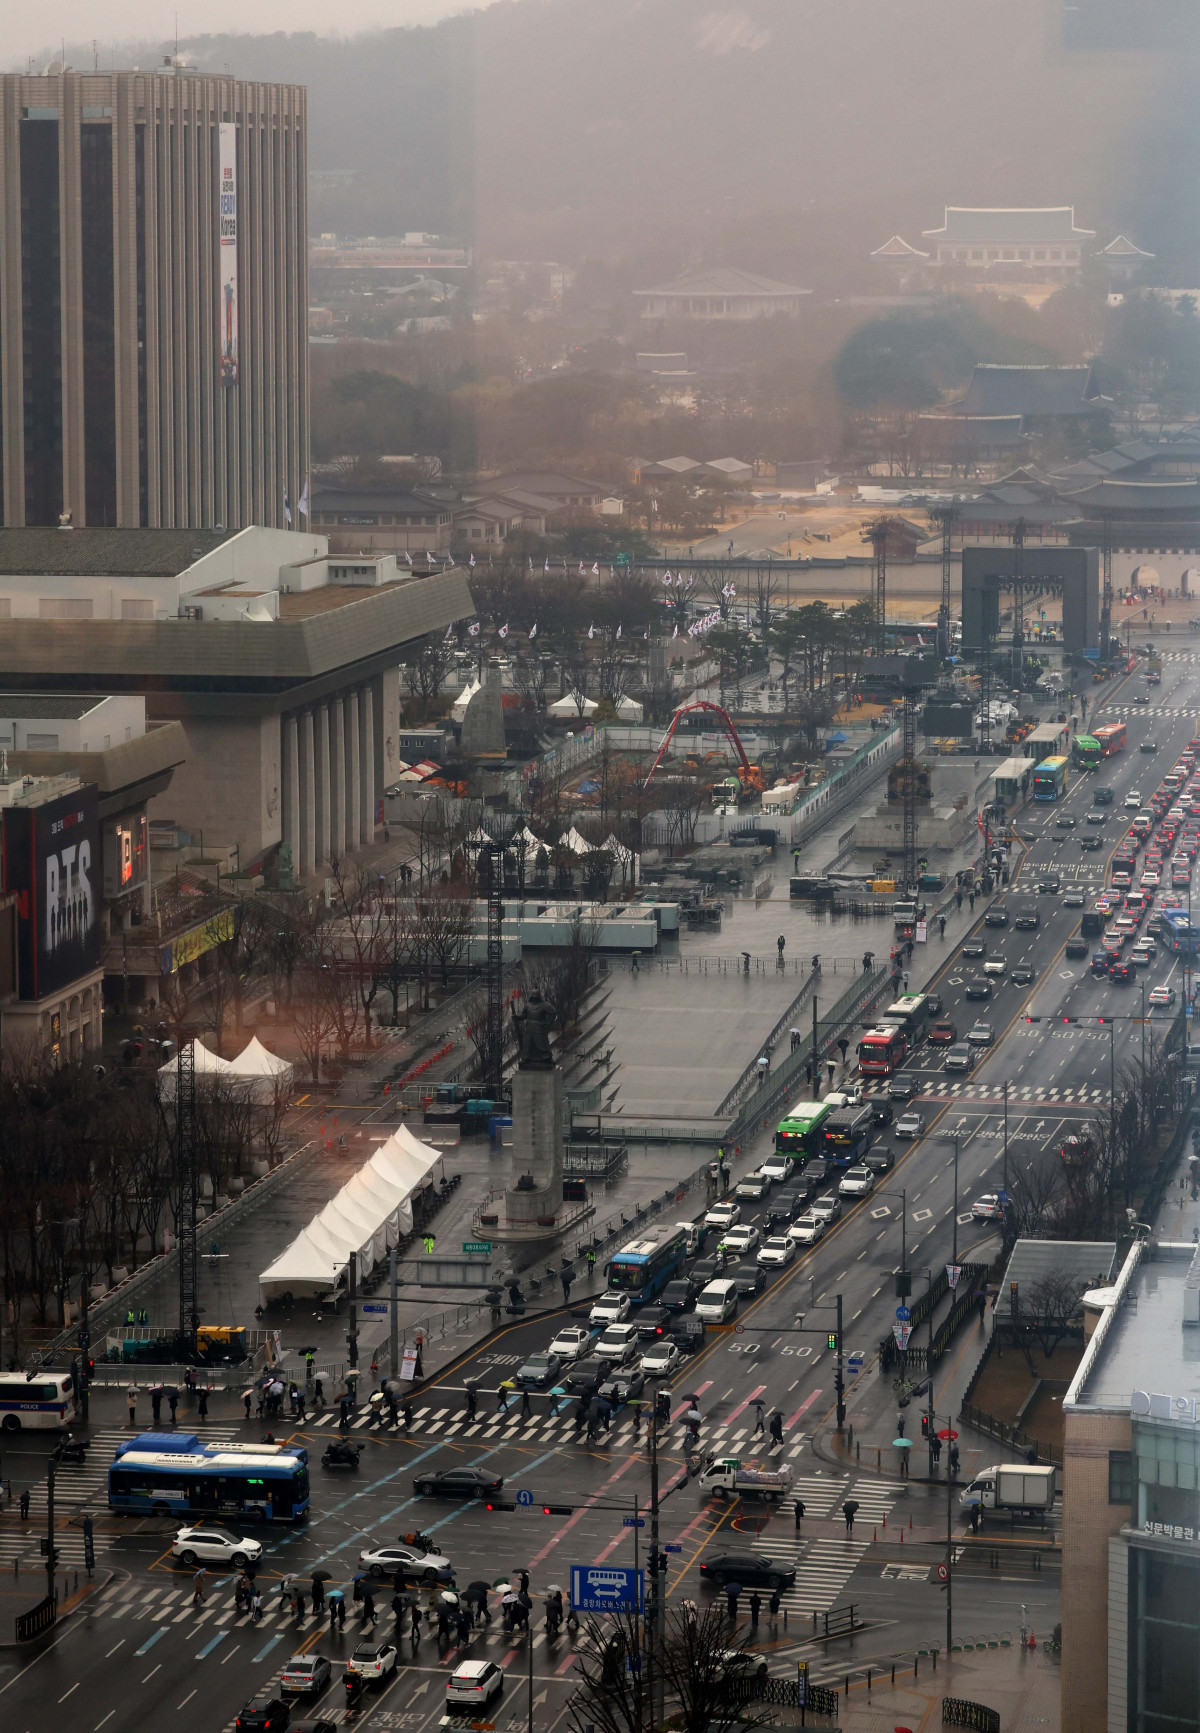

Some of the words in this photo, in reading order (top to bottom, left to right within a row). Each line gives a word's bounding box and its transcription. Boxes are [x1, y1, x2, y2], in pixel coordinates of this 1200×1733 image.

[220, 194, 235, 214] READY
[220, 215, 236, 236] Korea
[884, 823, 920, 832] 세종왕
[46, 839, 92, 950] BTS
[1016, 1029, 1040, 1038] 50
[1050, 1031, 1075, 1039] 50
[1086, 1032, 1110, 1041] 50
[727, 1342, 761, 1354] 50
[780, 1345, 813, 1357] 50
[1176, 1396, 1196, 1423] 일
[1143, 1520, 1195, 1541] 신문박물관
